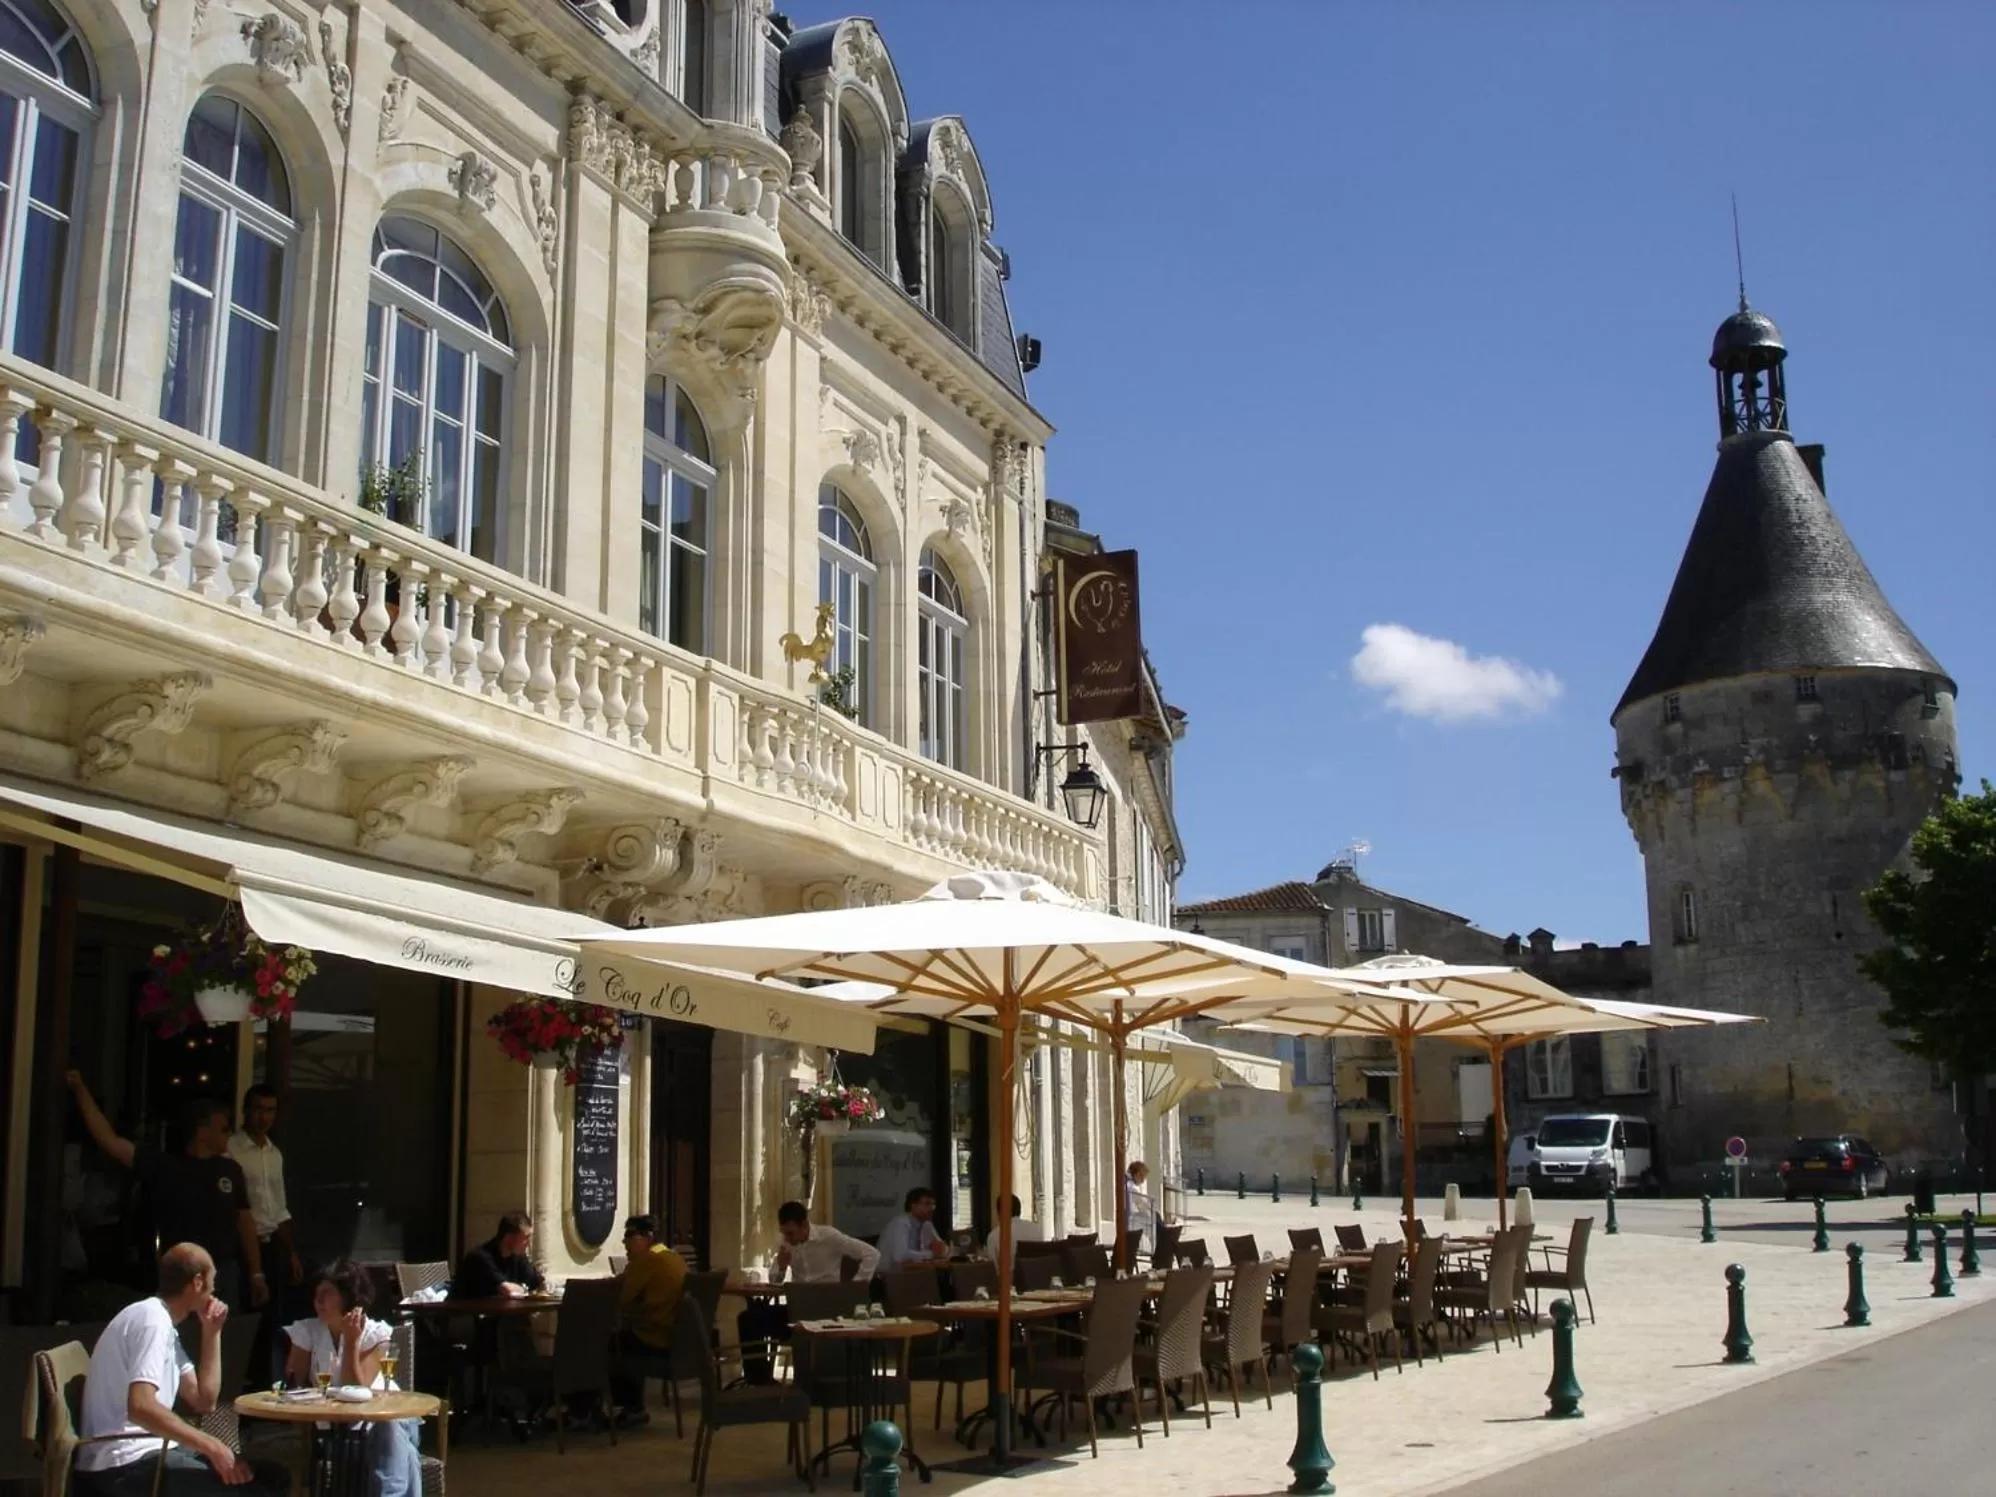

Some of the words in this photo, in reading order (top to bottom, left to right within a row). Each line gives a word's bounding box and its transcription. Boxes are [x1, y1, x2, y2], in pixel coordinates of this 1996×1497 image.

[401, 936, 474, 971] Brasserie
[552, 958, 586, 995] Le
[599, 966, 643, 1010] Coq
[650, 982, 698, 1016] d'Or
